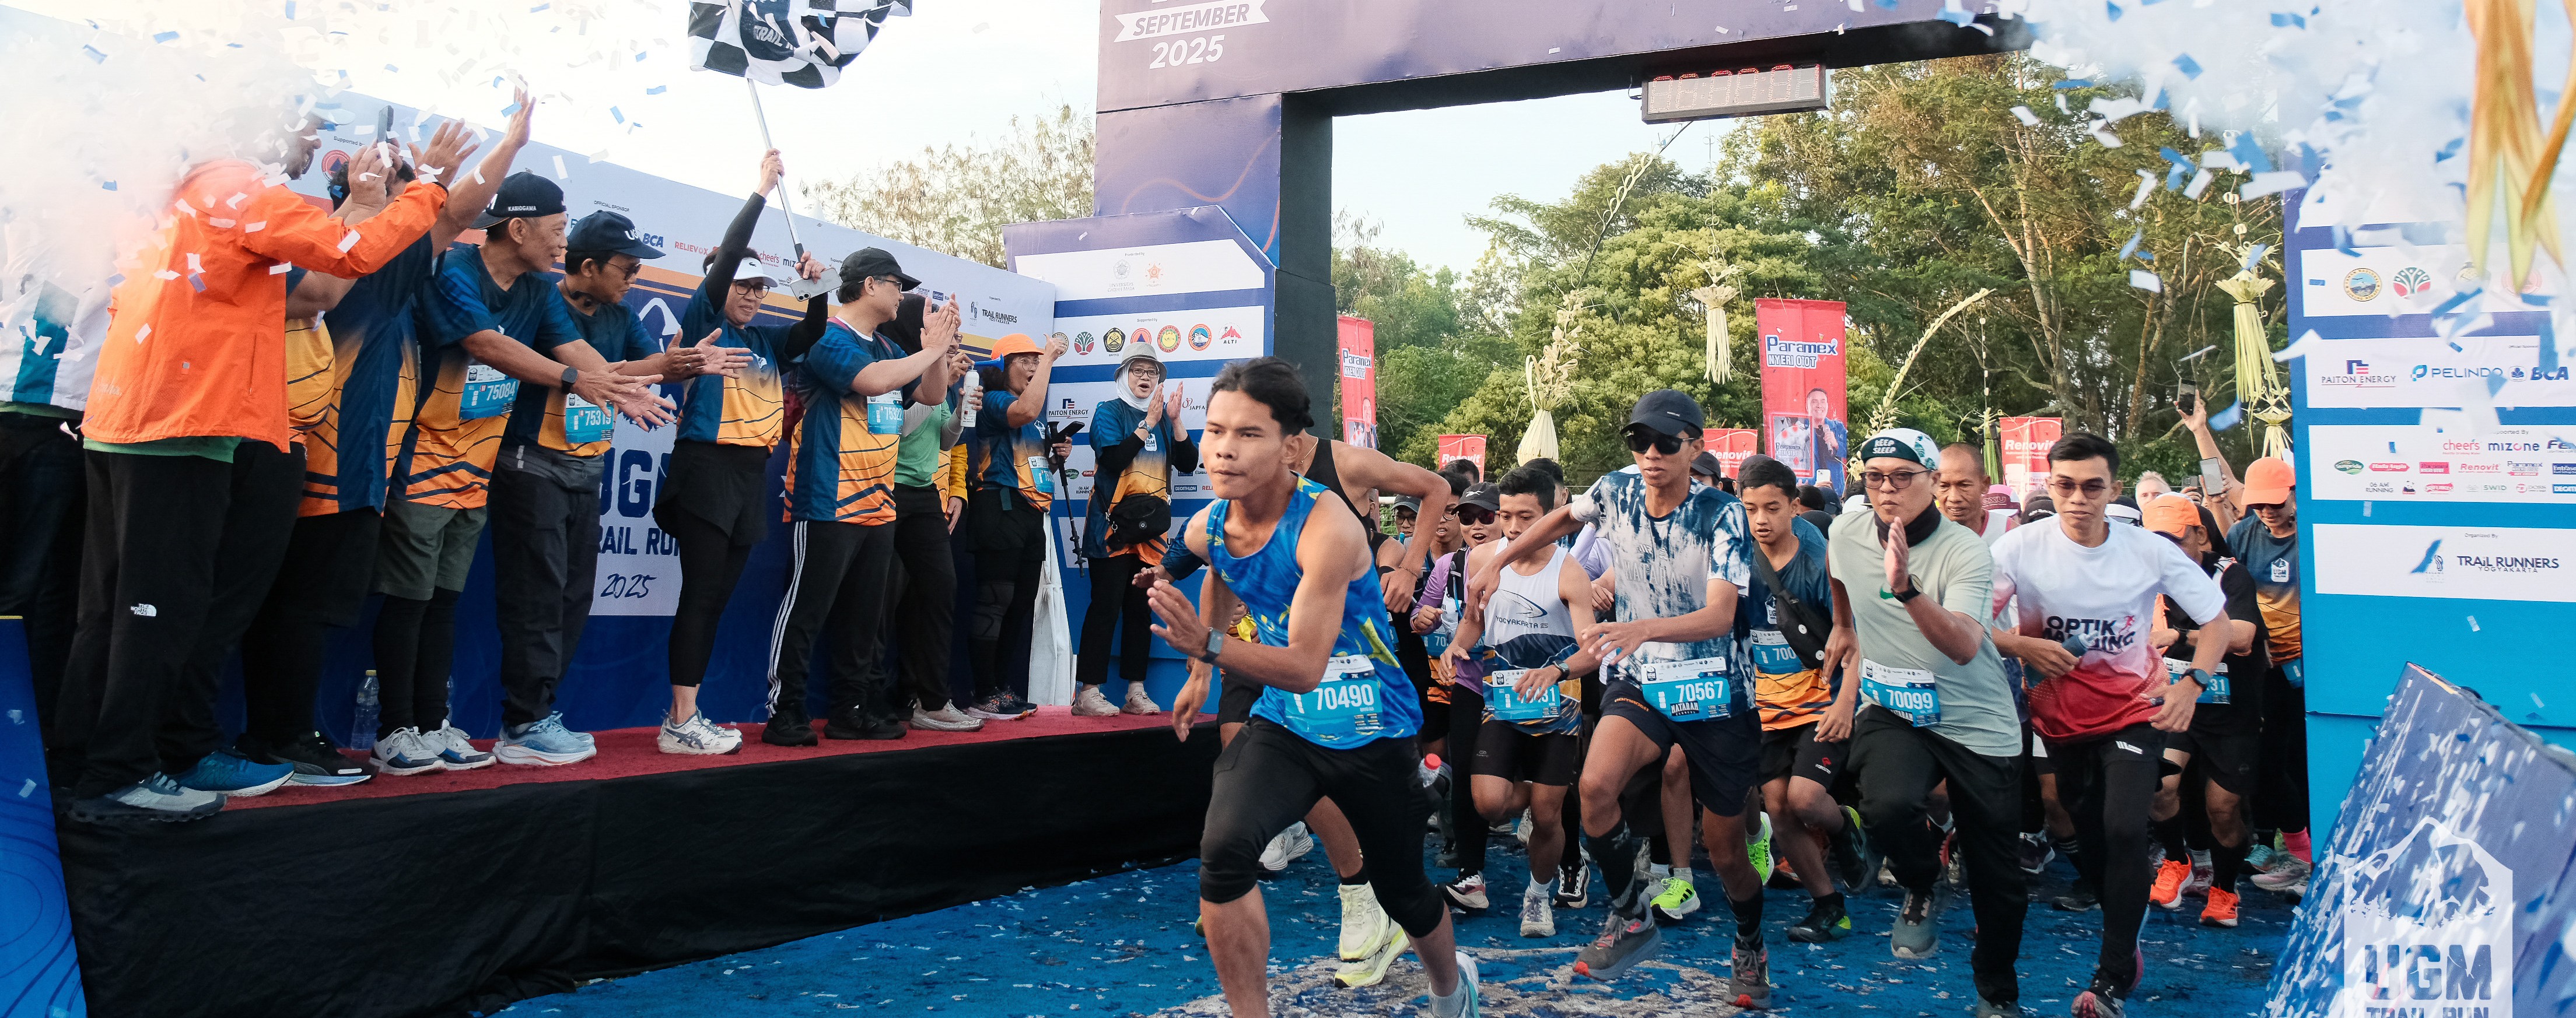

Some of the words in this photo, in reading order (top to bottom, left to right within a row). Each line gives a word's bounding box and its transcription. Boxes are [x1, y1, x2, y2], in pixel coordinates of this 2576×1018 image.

[1133, 3, 1250, 36] SEPTEMBER
[753, 25, 783, 47] TRAIL
[1149, 34, 1226, 69] 2025
[643, 233, 664, 248] BCA
[674, 241, 709, 255] RELIEVOX
[995, 313, 1017, 324] RUNNERS
[1767, 336, 1836, 354] Paramex
[1343, 350, 1371, 367] Paramex
[1768, 354, 1794, 366] NYERI
[2431, 367, 2503, 378] PELINDO
[2530, 366, 2569, 381] BCA
[487, 381, 516, 401] 75084
[884, 406, 902, 421] 75322
[2488, 443, 2539, 451] mizone
[2496, 557, 2560, 568] RUNNERS
[600, 573, 657, 599] 2025
[1495, 616, 1539, 629] YOGYAKARTA
[2047, 616, 2116, 636] OPTIK
[1772, 647, 1797, 661] 700
[1312, 684, 1374, 711] 70490
[1675, 681, 1723, 703] 70567
[1886, 689, 1934, 710] 70099
